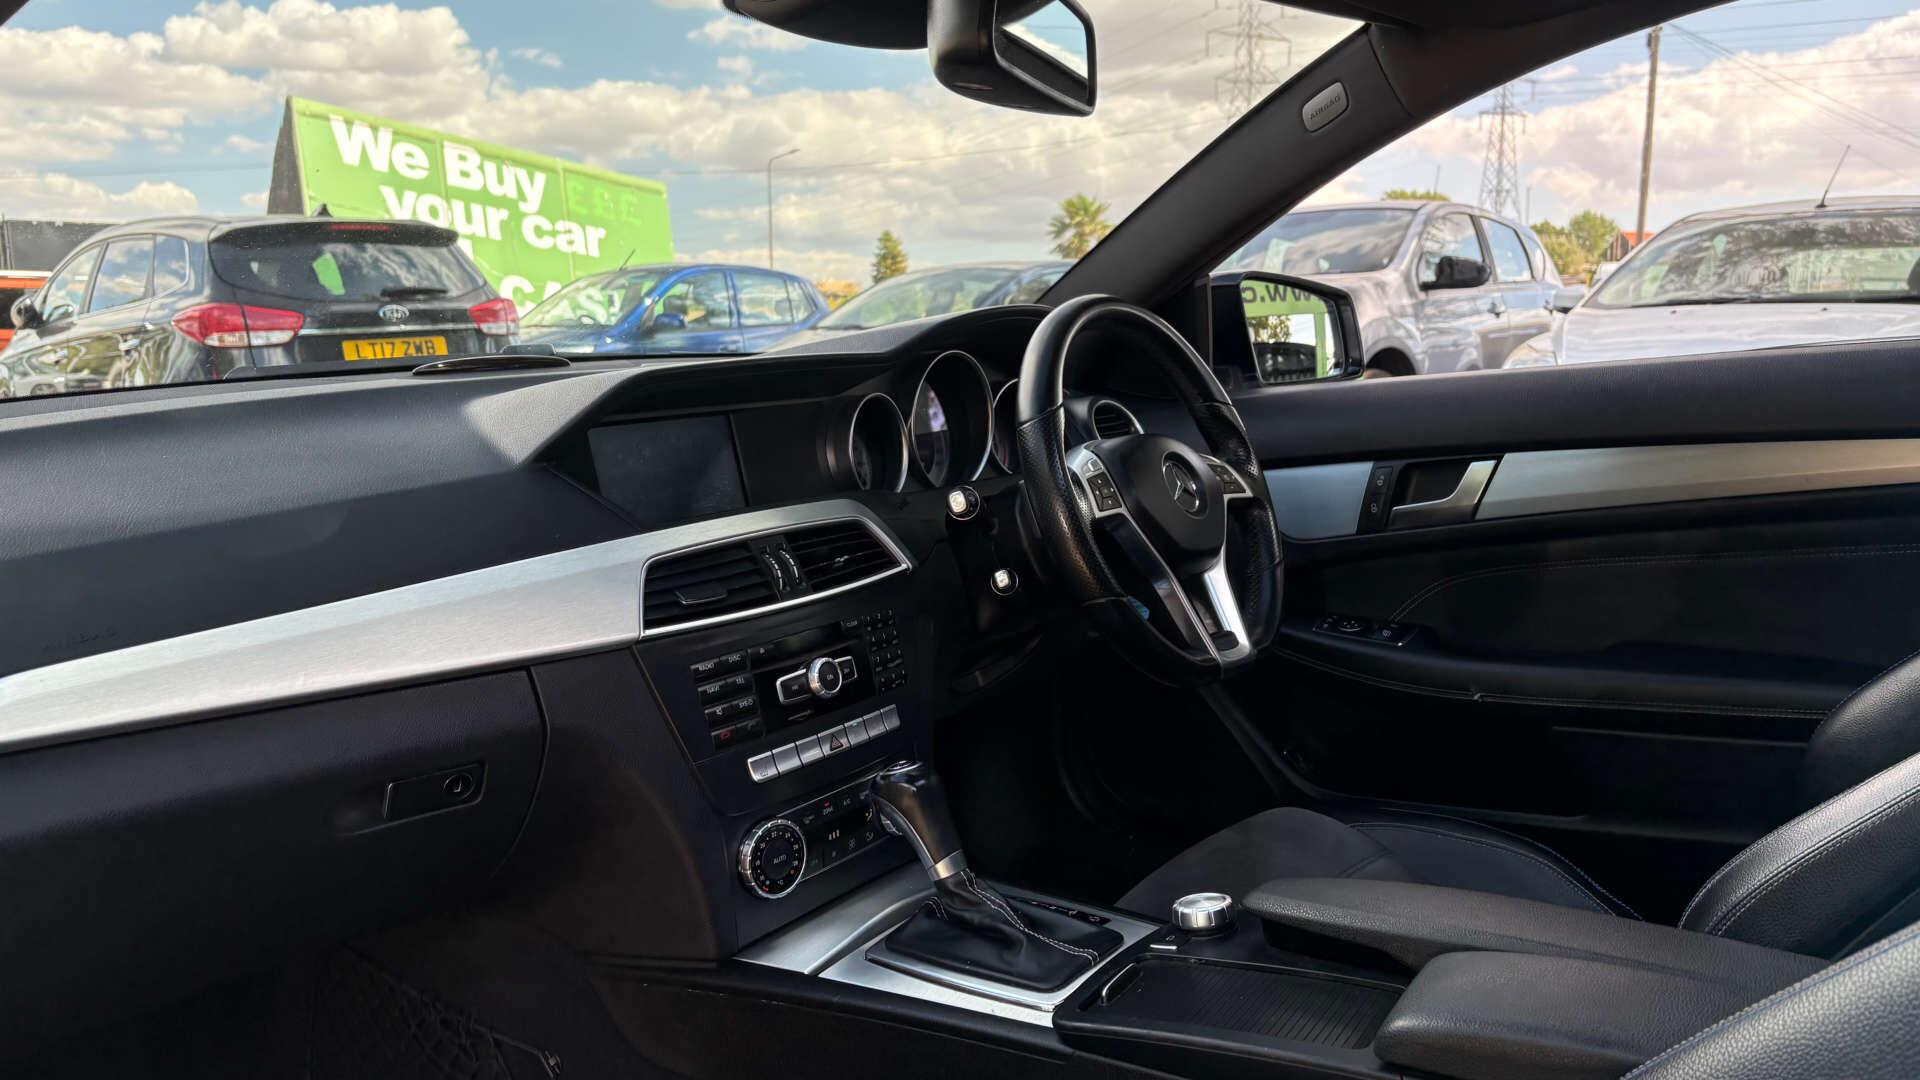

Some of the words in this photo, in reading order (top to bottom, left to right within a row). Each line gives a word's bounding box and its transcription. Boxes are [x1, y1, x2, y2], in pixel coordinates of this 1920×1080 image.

[329, 114, 431, 181] We
[442, 141, 547, 214] Buy
[378, 185, 510, 242] your
[521, 214, 607, 258] car
[354, 341, 396, 359] LT17
[773, 853, 788, 865] AUTO
